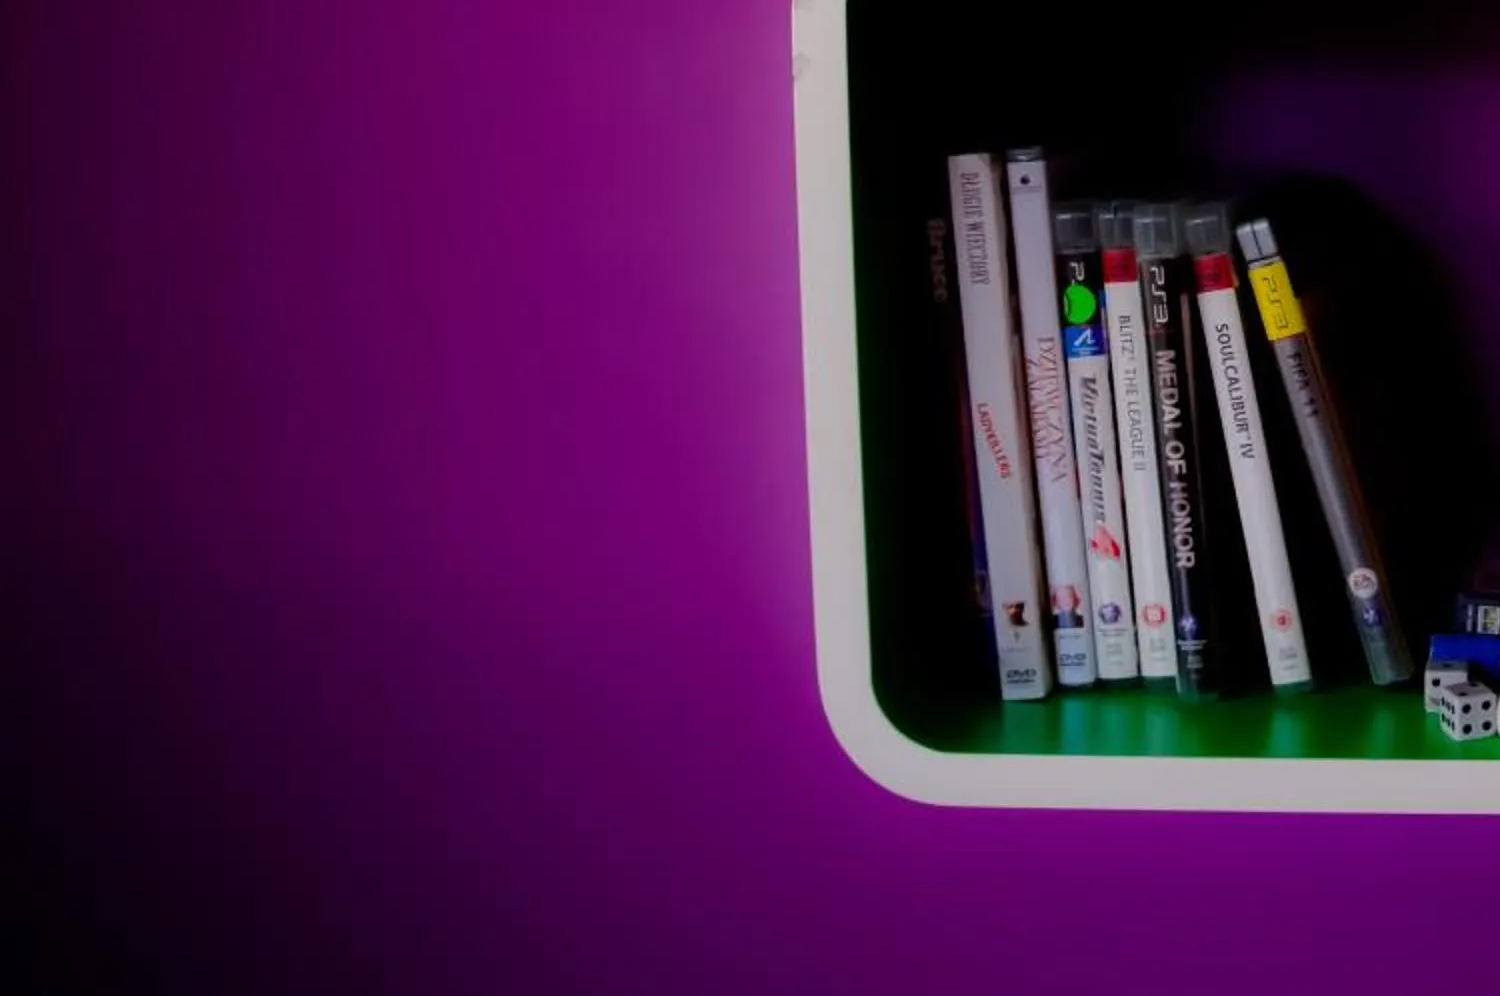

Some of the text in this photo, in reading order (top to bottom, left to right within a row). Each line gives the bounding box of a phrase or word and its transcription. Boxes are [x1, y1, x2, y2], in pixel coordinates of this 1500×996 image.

[1123, 367, 1138, 397] THE
[1128, 402, 1145, 458] LEAGUE
[1240, 442, 1256, 460] IV
[1155, 349, 1197, 570] MEDAL OF HONOR
